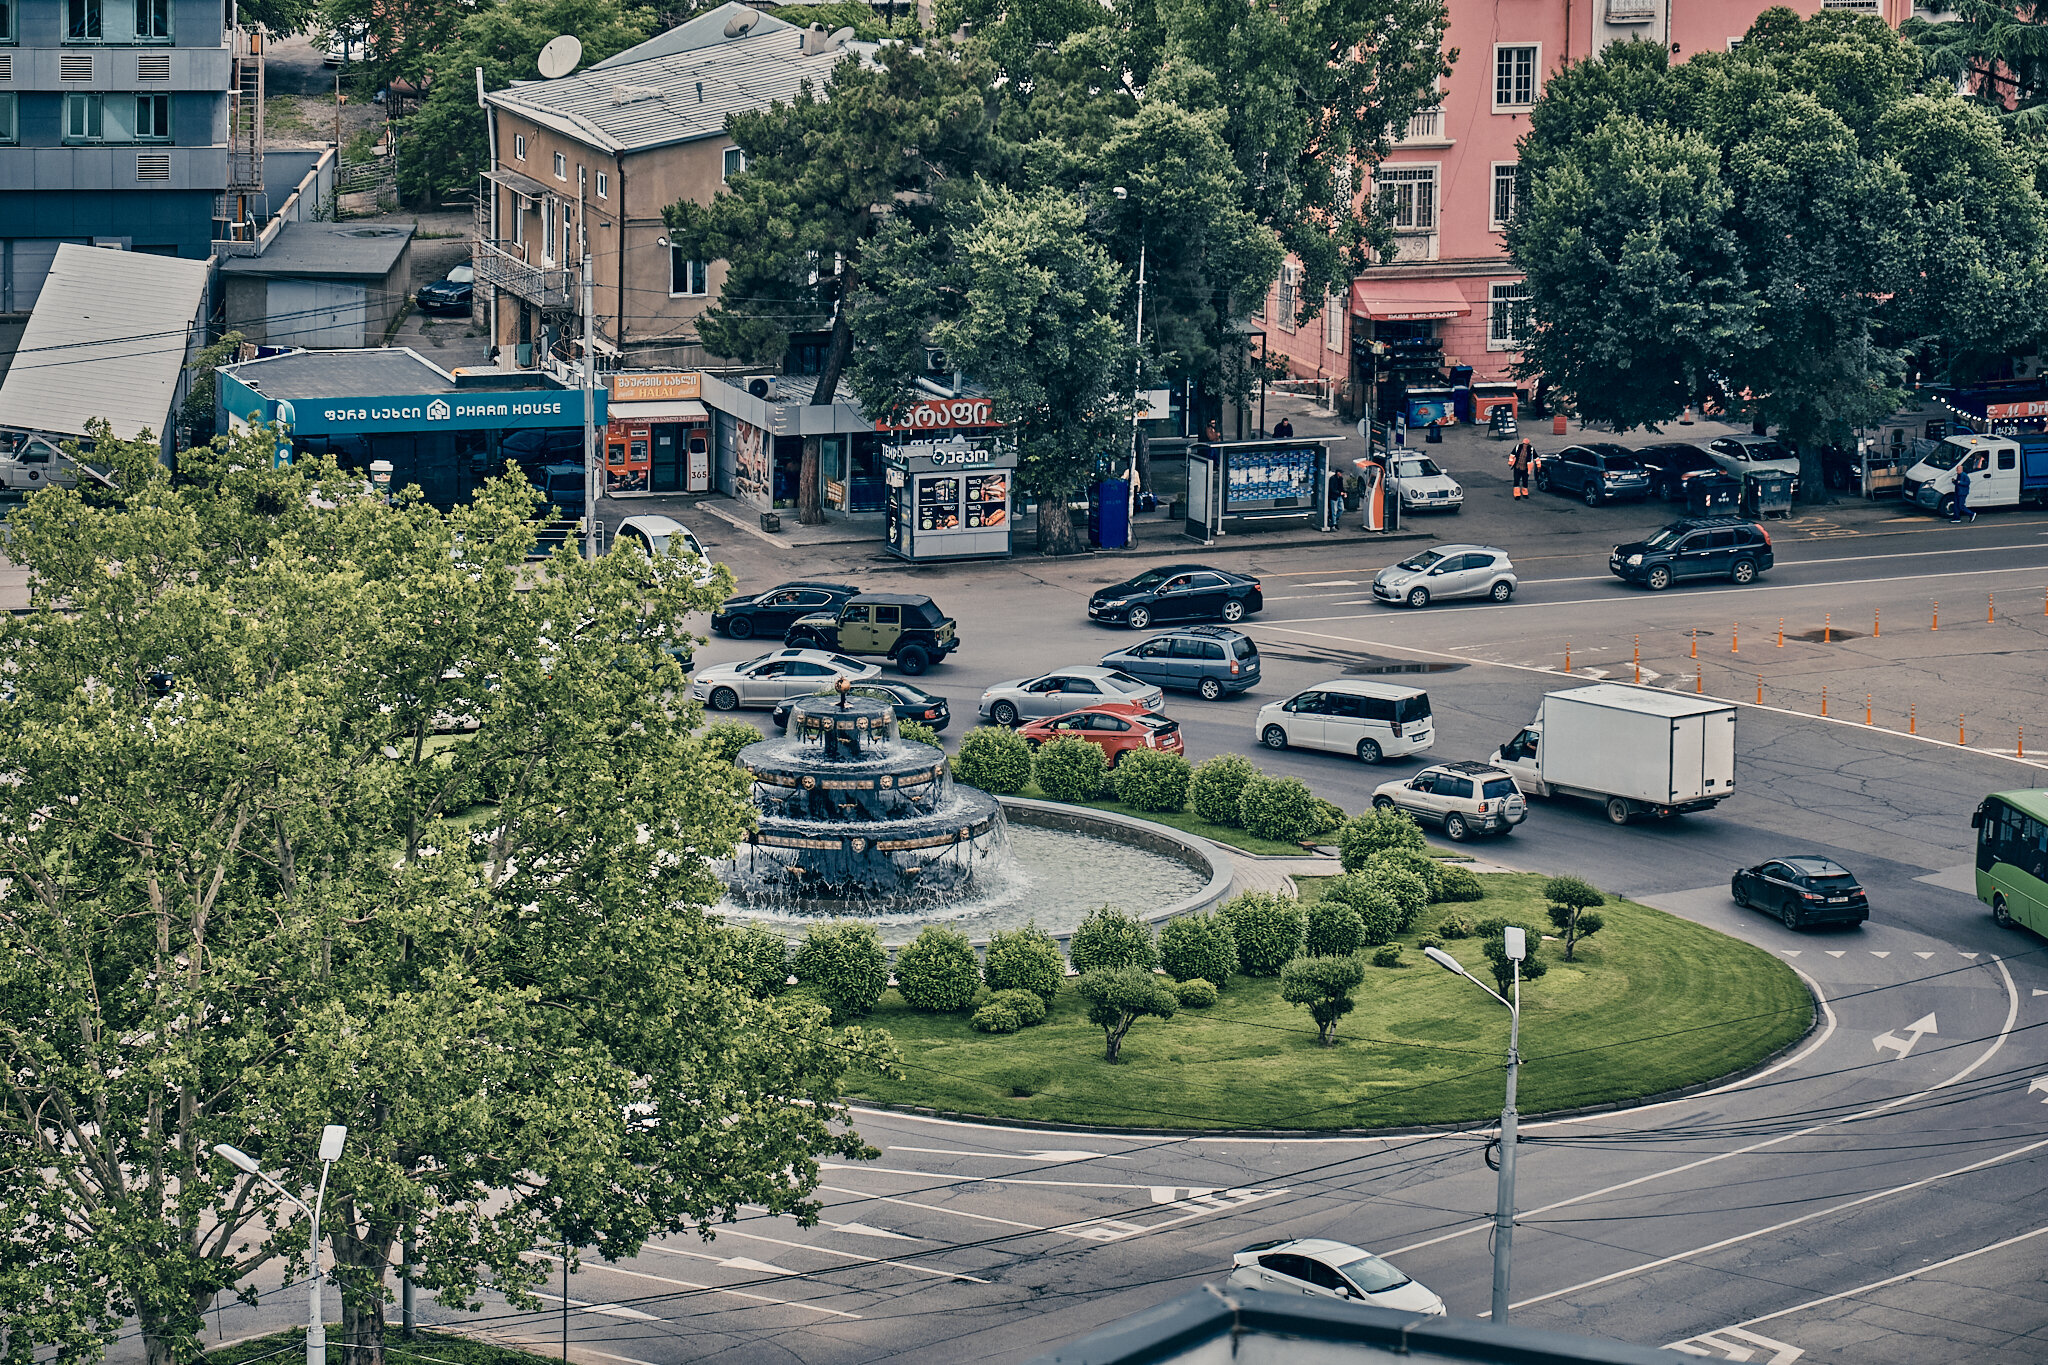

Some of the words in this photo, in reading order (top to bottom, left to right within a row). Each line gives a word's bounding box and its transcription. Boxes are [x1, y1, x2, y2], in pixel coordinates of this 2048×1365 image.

[618, 377, 662, 388] შაურმის
[664, 375, 697, 386] სახლი
[639, 388, 675, 398] HALAL
[456, 404, 508, 417] PHARM
[512, 402, 561, 415] HOUSE
[691, 471, 707, 479] 365
